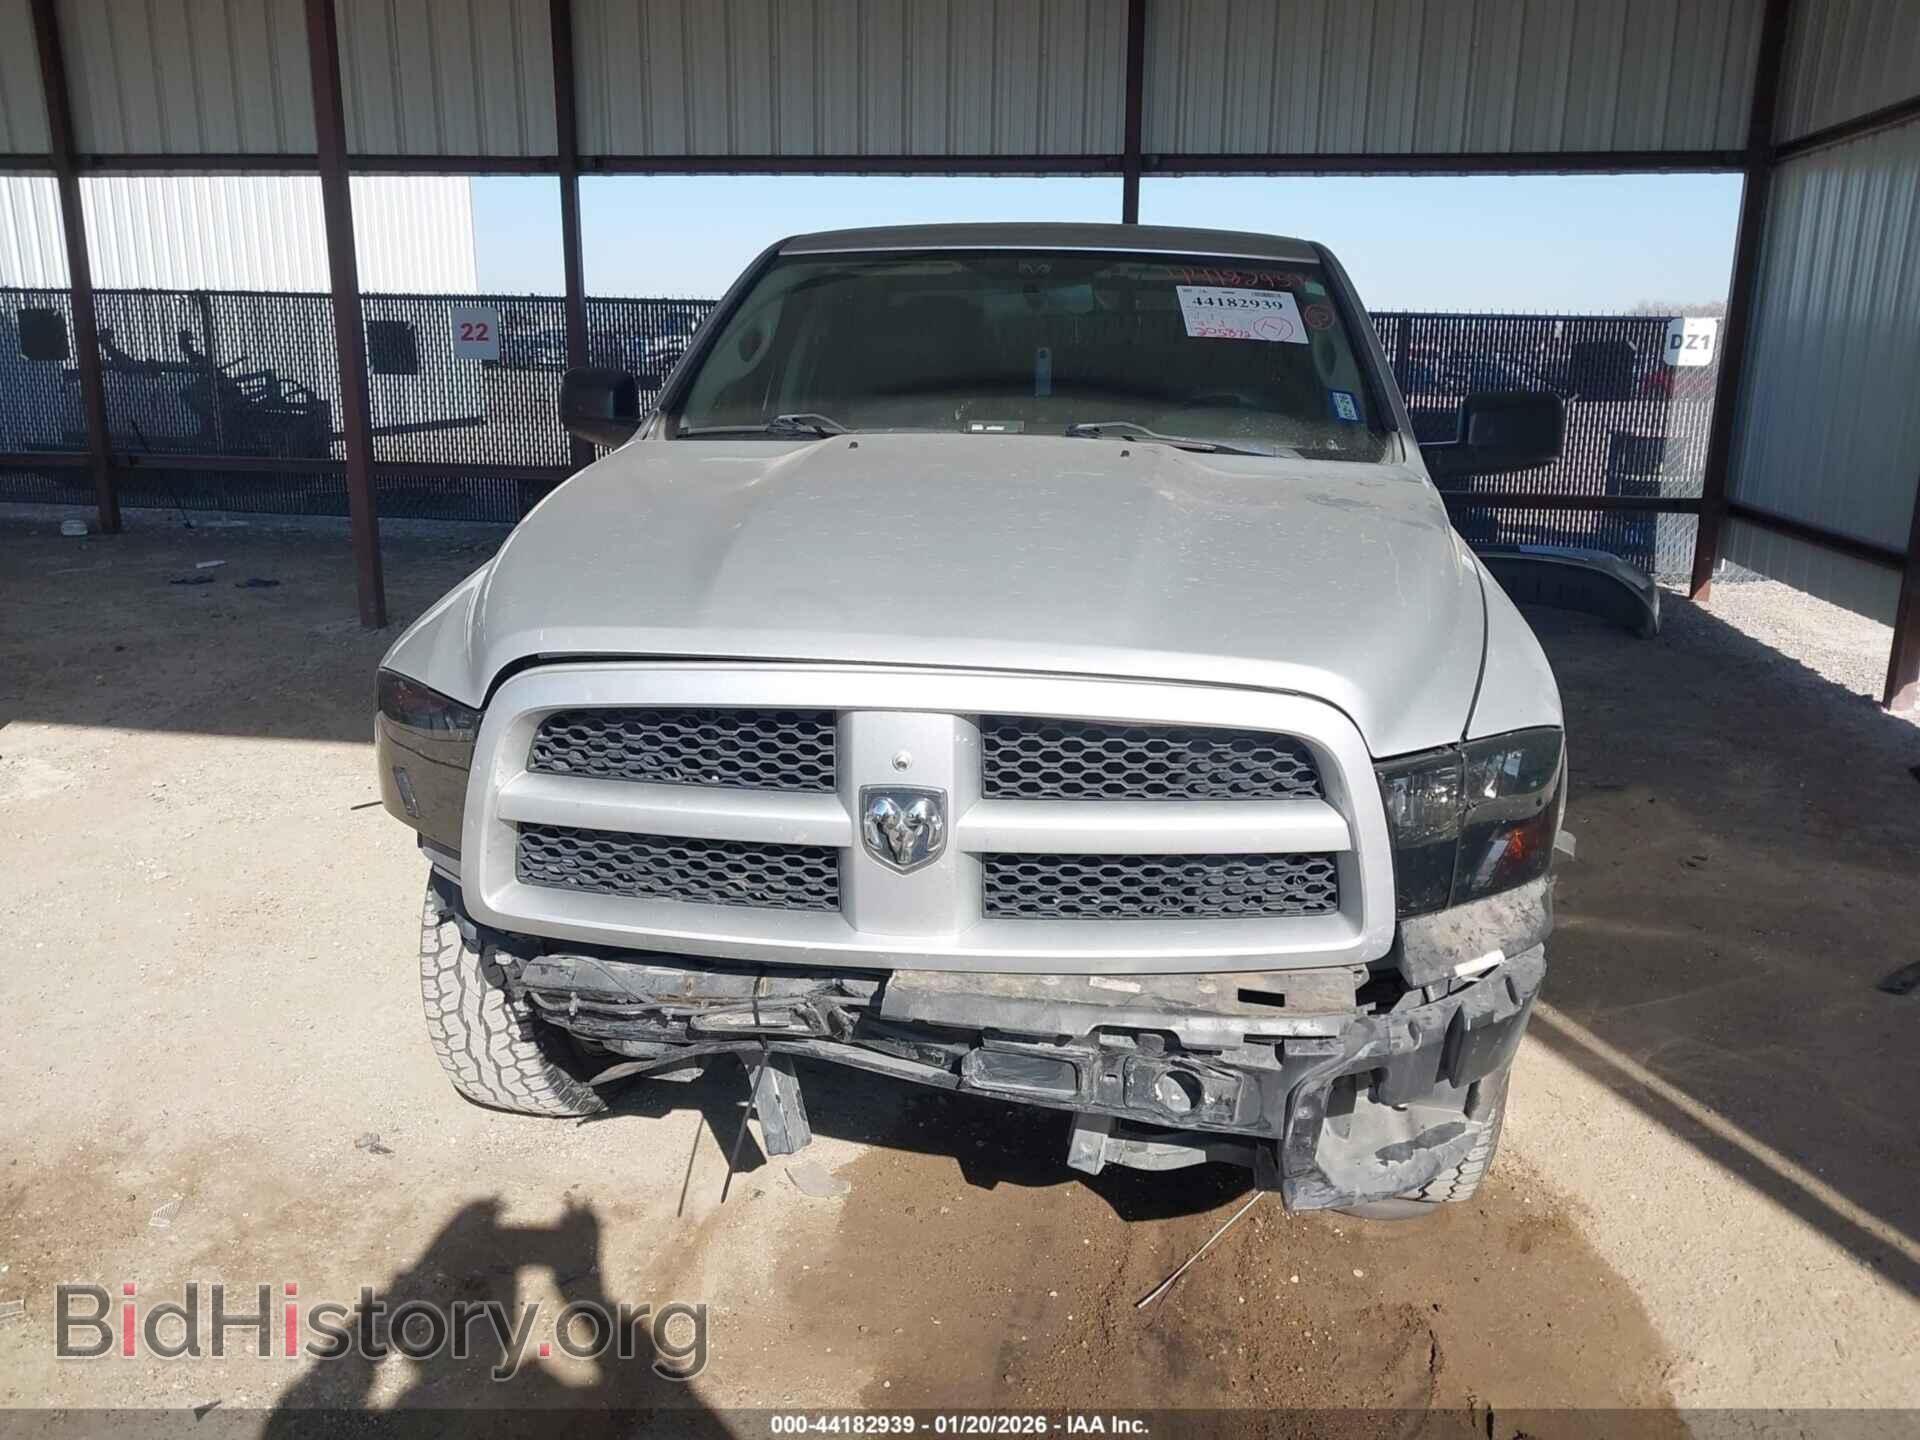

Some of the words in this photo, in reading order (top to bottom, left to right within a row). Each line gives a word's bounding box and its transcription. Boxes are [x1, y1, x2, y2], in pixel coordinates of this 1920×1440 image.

[1192, 296, 1283, 311] 44182939
[460, 322, 489, 341] 22
[1669, 333, 1711, 350] DZ1
